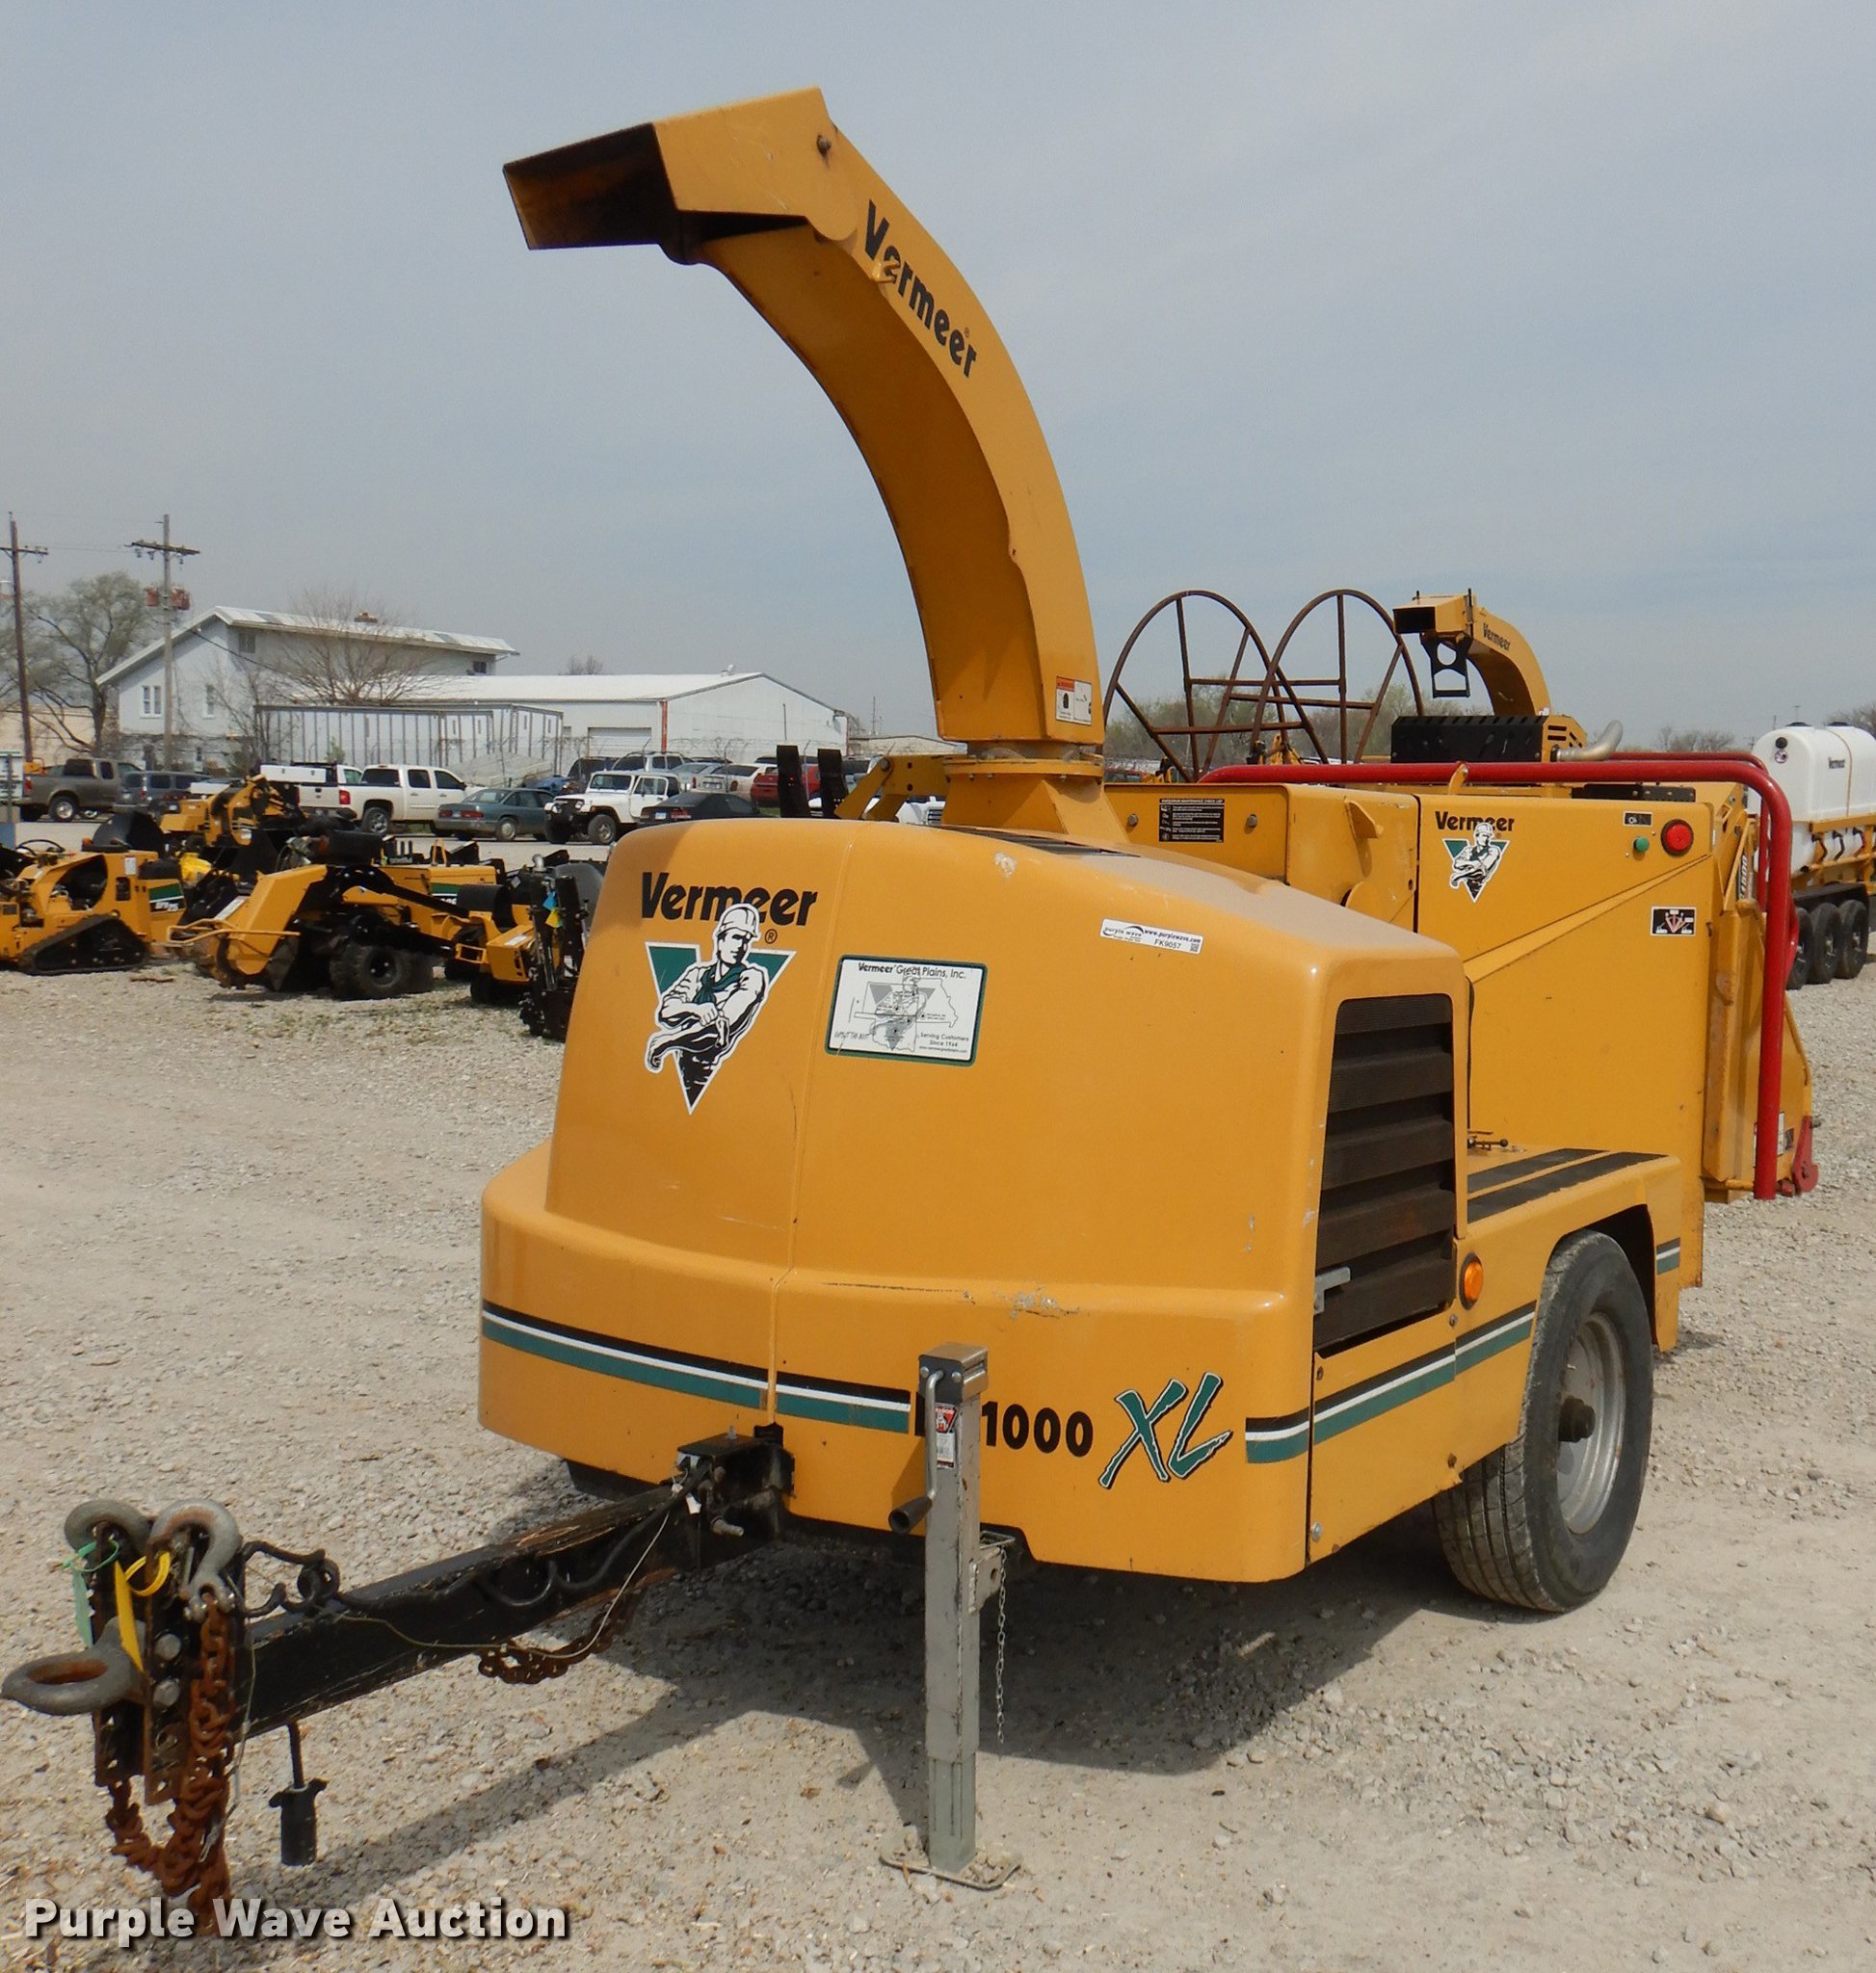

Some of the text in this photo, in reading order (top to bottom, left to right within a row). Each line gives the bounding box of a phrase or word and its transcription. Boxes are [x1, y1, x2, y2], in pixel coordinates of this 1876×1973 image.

[864, 198, 977, 378] Vermeer
[642, 872, 819, 927] Vermeer
[858, 962, 966, 980] Vermeer Great Plains, Inc.
[1154, 939, 1181, 949] FK9057
[981, 1401, 1094, 1458] 1000
[1098, 1371, 1233, 1489] XL
